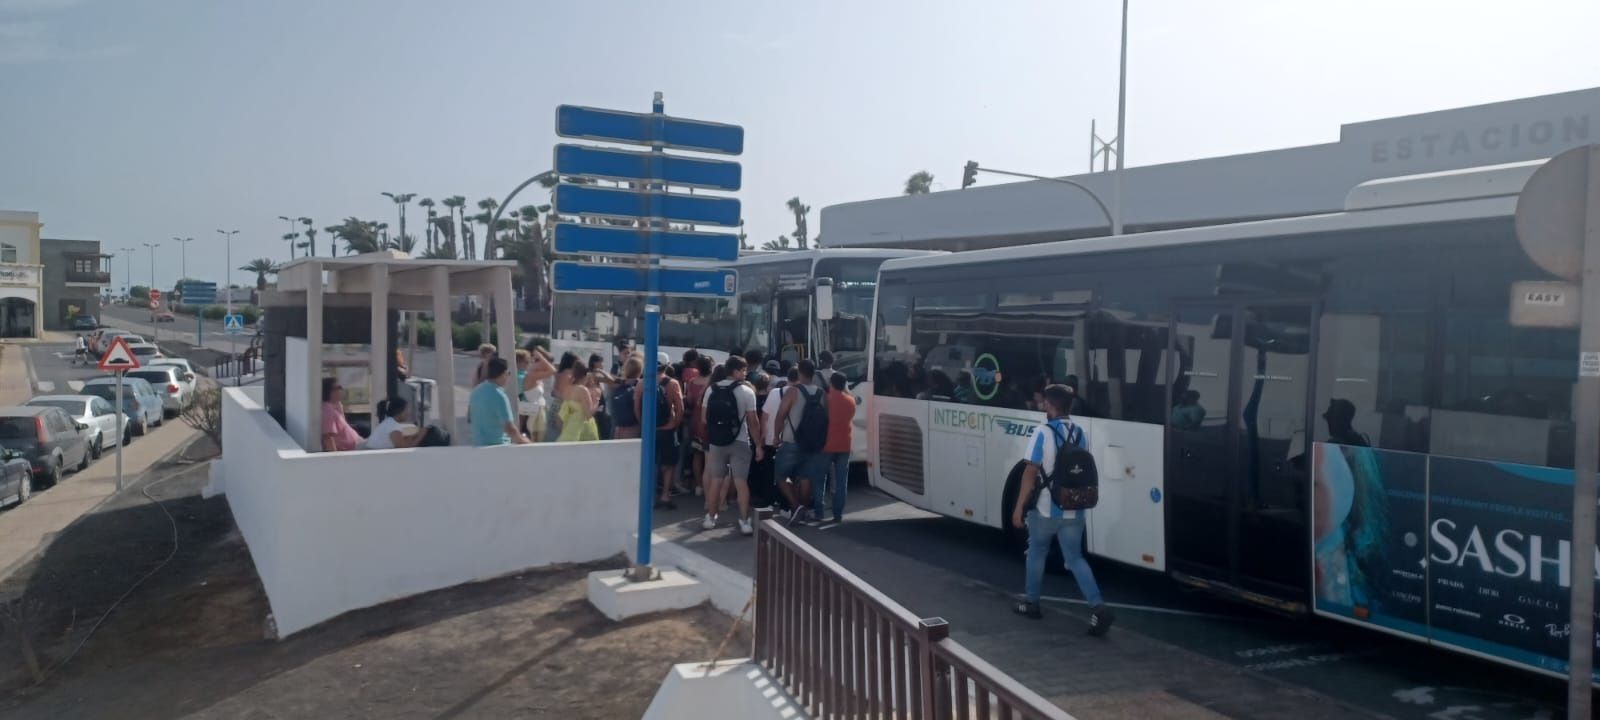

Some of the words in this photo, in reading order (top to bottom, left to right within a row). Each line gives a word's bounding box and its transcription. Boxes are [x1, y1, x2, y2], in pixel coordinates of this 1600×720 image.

[1371, 114, 1590, 164] ESTACION
[1528, 293, 1560, 302] EASY
[934, 407, 996, 432] INTERCITY
[1430, 518, 1572, 589] SASH
[1518, 595, 1559, 609] GUCCI
